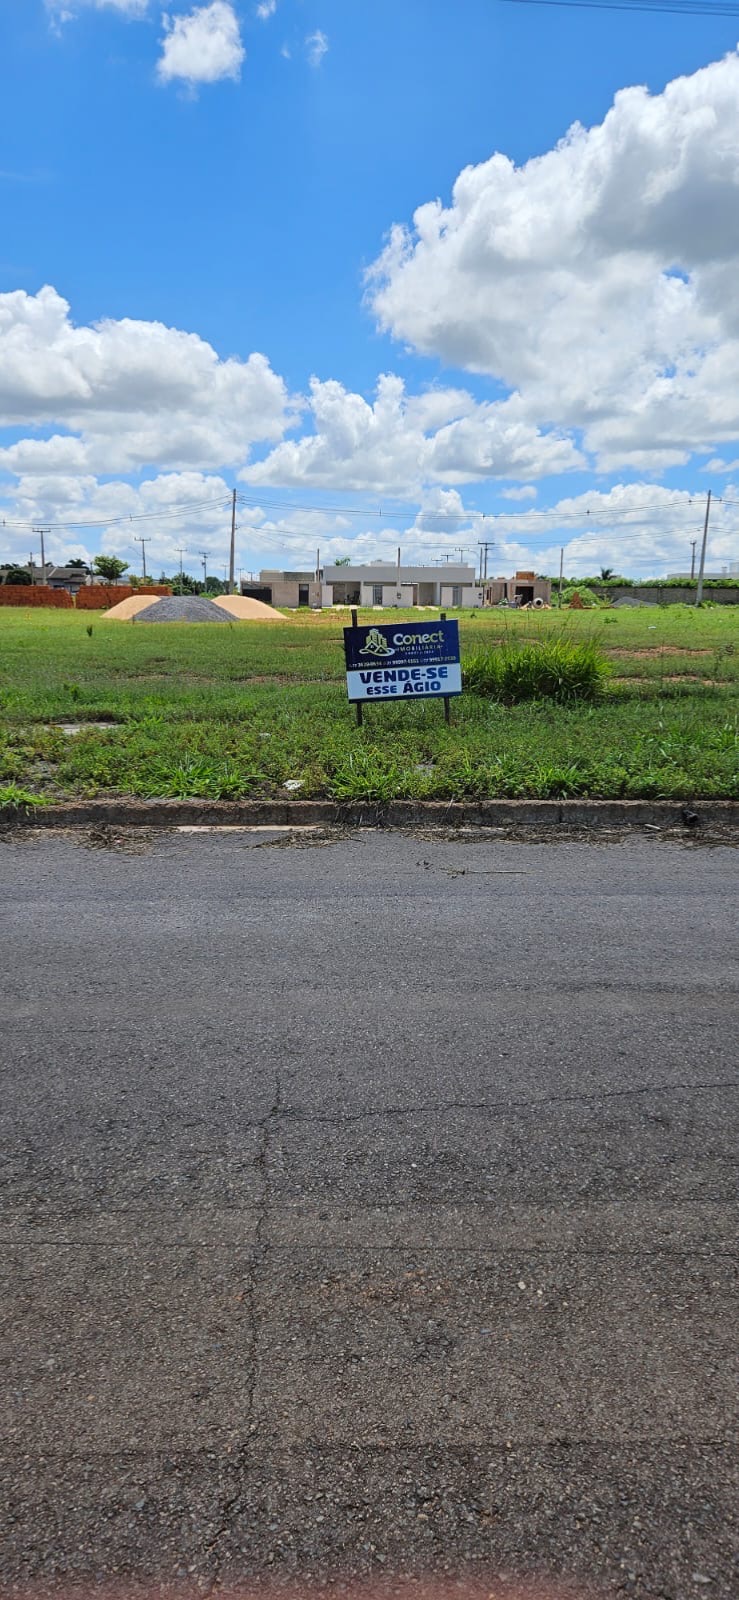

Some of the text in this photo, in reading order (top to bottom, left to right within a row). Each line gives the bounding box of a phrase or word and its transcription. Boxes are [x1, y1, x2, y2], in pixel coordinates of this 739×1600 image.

[393, 630, 444, 645] Conect
[360, 667, 448, 684] VENDE-SE
[366, 680, 441, 696] ESSE ÁGIO
